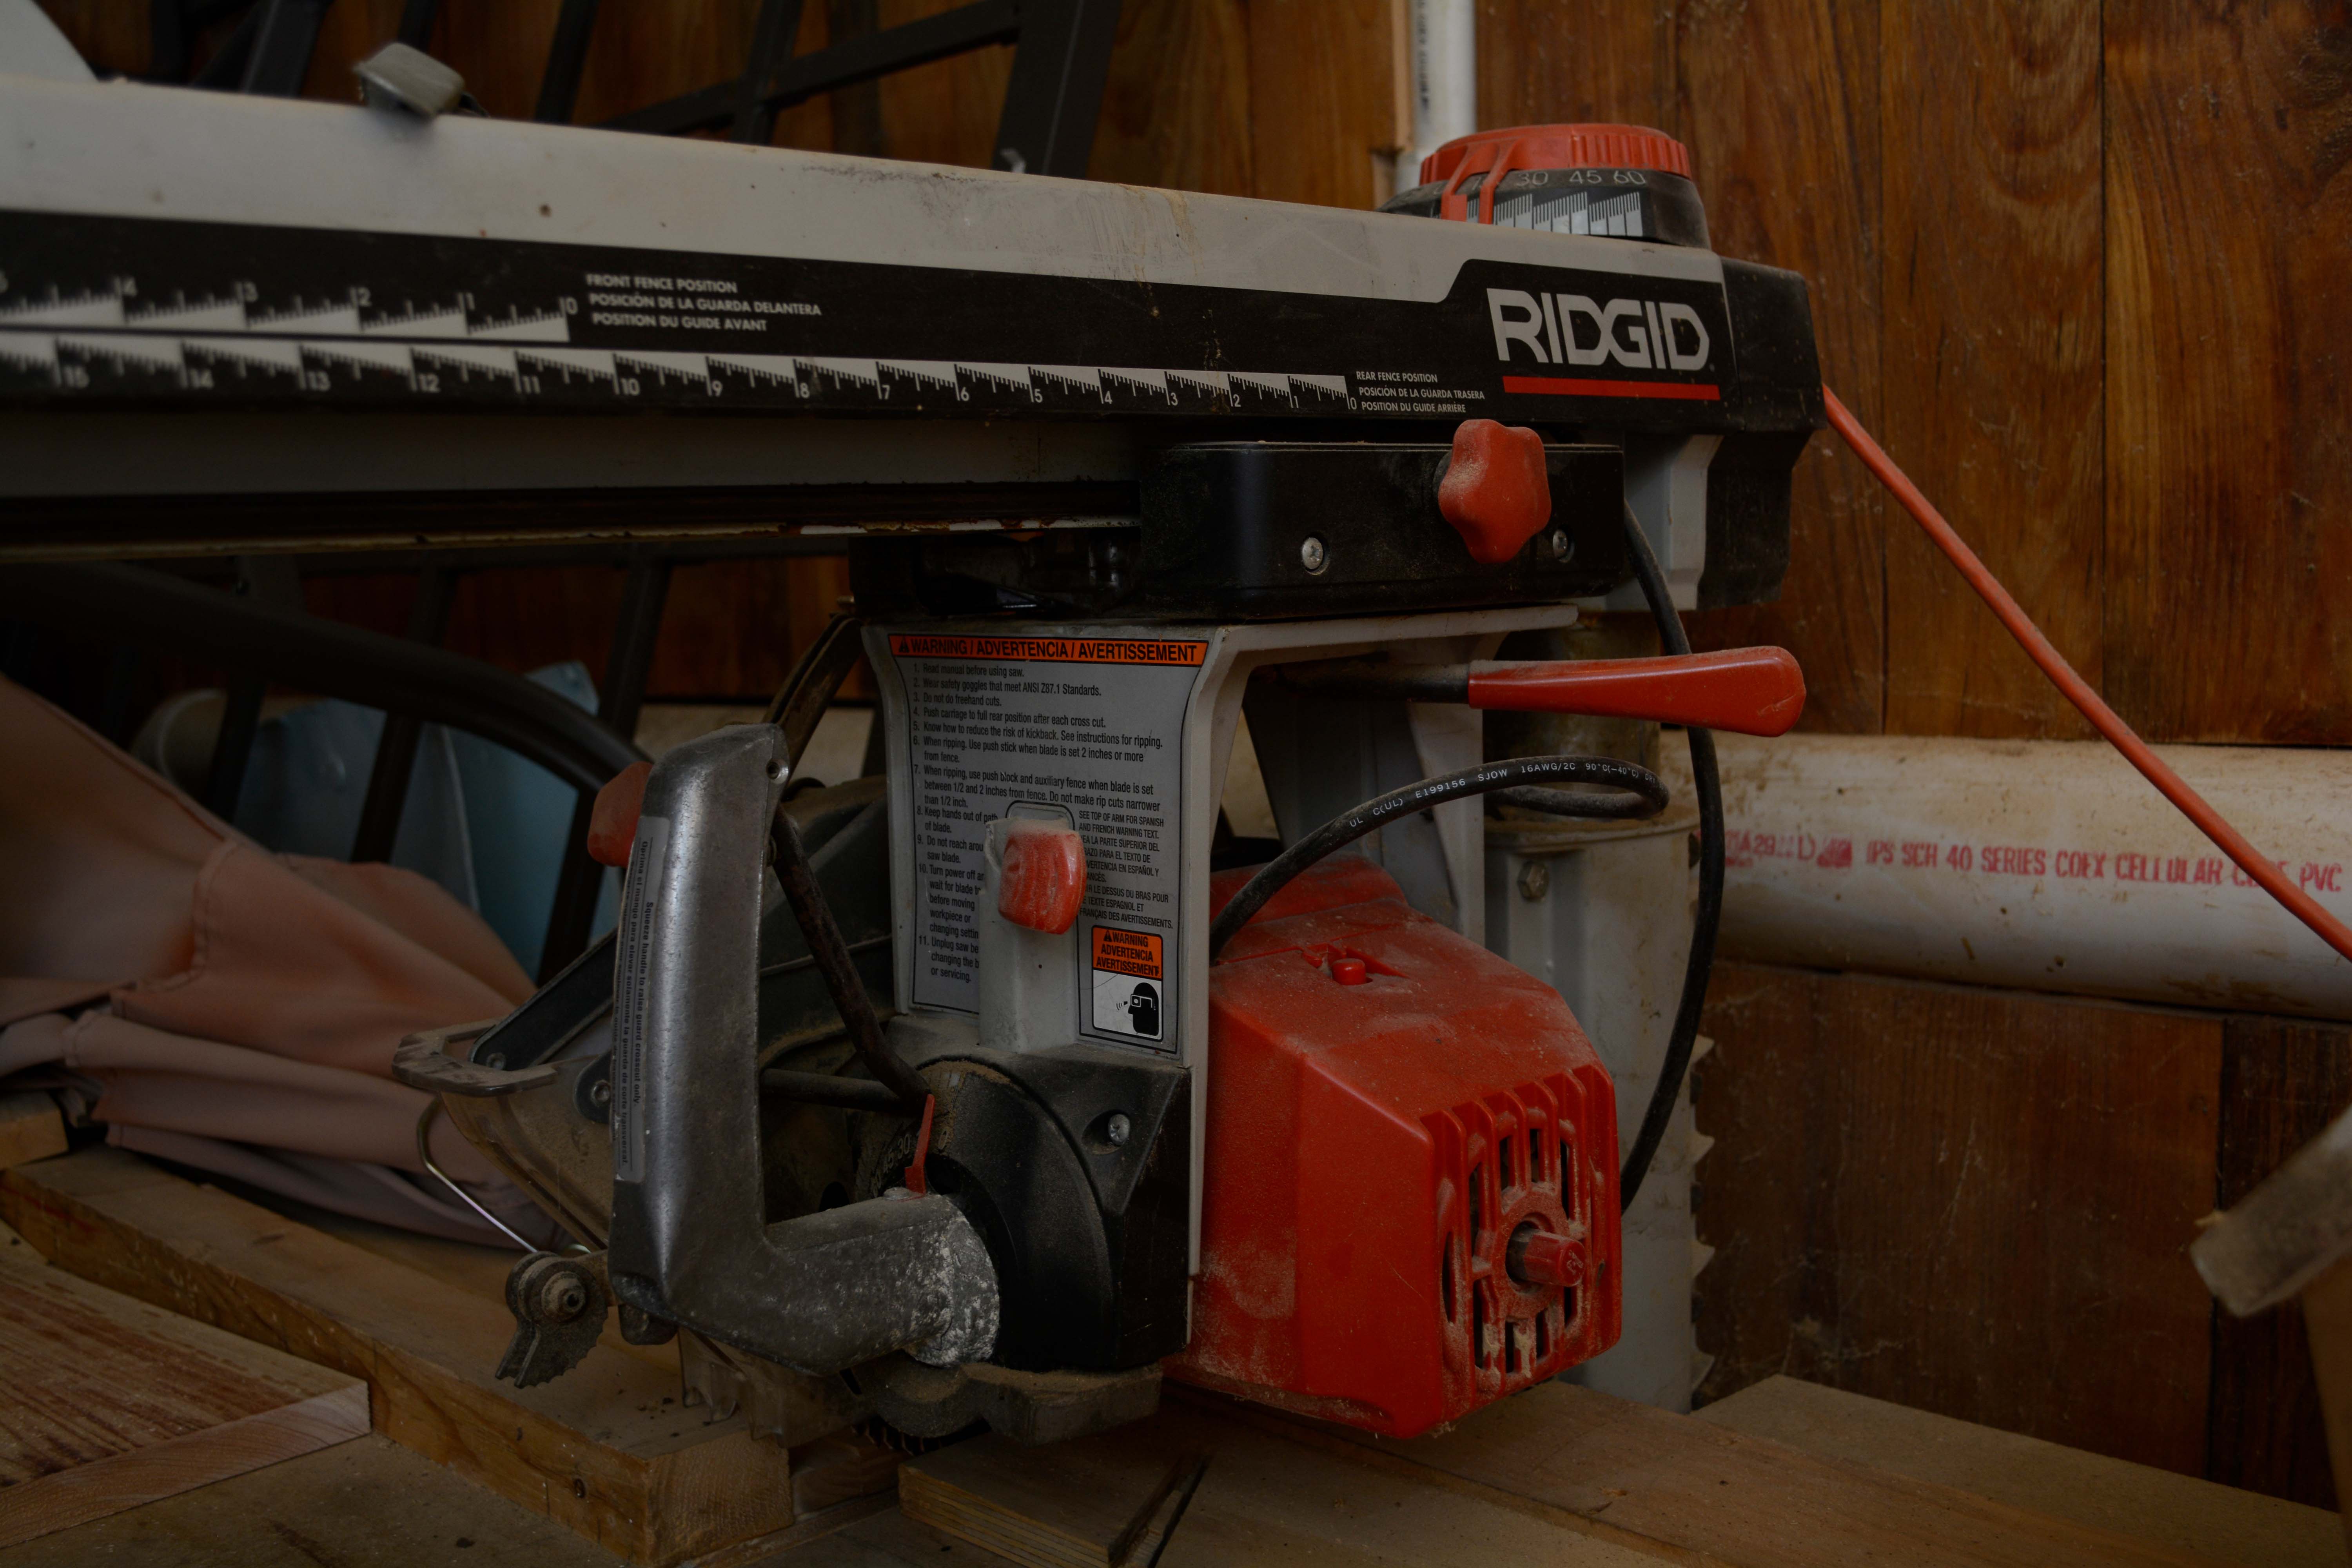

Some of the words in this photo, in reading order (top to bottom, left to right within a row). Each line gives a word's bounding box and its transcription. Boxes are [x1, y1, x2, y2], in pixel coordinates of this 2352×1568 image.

[1515, 171, 1548, 186] 30
[1570, 170, 1601, 184] 45
[1613, 171, 1646, 185] 60
[586, 274, 630, 287] FRONT
[634, 276, 673, 290] FENCE
[676, 278, 737, 293] POSITION
[123, 276, 138, 297] 4
[244, 279, 258, 303] 3
[358, 287, 371, 308] 2
[566, 297, 578, 314] 0
[589, 291, 655, 308] POSICIÓN
[657, 296, 674, 309] DE
[677, 298, 694, 310] LA
[696, 298, 751, 312] GUARDA
[753, 301, 822, 316] DELANTERA
[592, 312, 657, 327] POSITION
[659, 315, 679, 328] DU
[681, 316, 720, 330] GUIDE
[724, 318, 767, 331] AVANT
[1486, 288, 1710, 371] RIDGID
[1356, 371, 1376, 380] REAR
[1377, 372, 1400, 381] FENCE
[1402, 373, 1437, 382] POSITION
[308, 369, 330, 391] 13
[419, 374, 441, 392] 12
[522, 376, 541, 394] 11
[620, 378, 641, 396] 10
[711, 381, 723, 397] 9
[800, 383, 810, 399] 8
[882, 385, 890, 400] 7
[960, 387, 970, 401] 6
[1034, 389, 1043, 403] 5
[1104, 391, 1112, 404] 4
[1171, 392, 1178, 406] 3
[1234, 394, 1241, 408] 2
[1350, 397, 1357, 410] 0
[1359, 385, 1396, 396] POSICIÓN
[1410, 388, 1419, 397] LA
[1421, 389, 1452, 397] GUARDA
[1454, 390, 1485, 399] TRASERA
[1361, 401, 1398, 410] POSITION
[1400, 403, 1410, 411] DU
[1413, 403, 1435, 412] GUIDE
[1438, 402, 1465, 412] ARRIÈRE
[911, 639, 967, 654] WARNING
[977, 640, 1068, 657] ADVERTENCIA
[1078, 642, 1196, 661] AVERTISSEMENT
[914, 663, 919, 672] 1.
[923, 663, 939, 673] Read
[941, 664, 964, 674] manual
[966, 664, 987, 675] before
[989, 665, 1007, 678] using
[1009, 668, 1024, 677] saw.
[913, 677, 919, 687] 2.
[923, 677, 939, 688] Wear
[941, 679, 960, 690] safety
[962, 680, 987, 691] goggles
[989, 681, 1002, 691] that
[1004, 682, 1021, 691] meet
[1023, 682, 1038, 693] ANSI
[1041, 682, 1059, 693] Z87.1
[1063, 683, 1101, 695] Standards.
[913, 691, 919, 702] 3.
[924, 692, 931, 702] Do
[934, 693, 944, 702] not
[946, 694, 953, 703] do
[955, 694, 983, 705] freehand
[985, 696, 1001, 706] cuts.
[913, 706, 919, 716] 4.
[924, 707, 939, 717] Push
[941, 708, 967, 720] carriage
[969, 710, 975, 719] to
[977, 710, 987, 720] full
[989, 713, 1002, 721] rear
[1005, 712, 1031, 722] position
[1033, 713, 1049, 724] after
[1051, 715, 1068, 725] each
[1071, 717, 1090, 726] cross
[1092, 717, 1105, 728] cut.
[1349, 817, 1364, 828] UL
[1372, 798, 1404, 816] C(UL)
[1415, 779, 1466, 799] E199156
[1477, 769, 1508, 781] SJOW
[1521, 762, 1576, 773] 16AWG/2C
[1079, 810, 1089, 819] SEE
[1091, 811, 1101, 820] TOP
[1103, 813, 1110, 821] OF
[1111, 814, 1124, 822] ARM
[1126, 815, 1137, 824] FOR
[1139, 816, 1163, 826] SPANISH
[1079, 823, 1090, 831] AND
[1093, 824, 1114, 833] FRENCH
[1116, 827, 1142, 837] WARNING
[1143, 829, 1158, 838] TEXT.
[1091, 836, 1098, 844] LA
[1100, 837, 1117, 846] PARTE
[1119, 839, 1147, 850] SUPERIOR
[1149, 842, 1160, 851] DEL
[637, 841, 648, 874] Oprima
[1099, 849, 1113, 858] PARA
[1115, 851, 1122, 859] EL
[1123, 852, 1141, 862] TEXTO
[1143, 854, 1150, 863] DE
[1867, 840, 1894, 864] IPS
[1901, 840, 1938, 868] SCH
[1947, 844, 1973, 871] 40
[1982, 846, 2046, 876] SERIES
[2115, 853, 2223, 885] CELLULAR
[2299, 862, 2342, 891] PVC
[1118, 864, 1126, 872] EN
[1128, 865, 1154, 876] ESPAÑOL
[1155, 868, 1159, 876] Y
[635, 877, 642, 885] el
[1094, 885, 1100, 893] LE
[1102, 886, 1124, 897] DESSUS
[1126, 889, 1133, 898] DU
[1136, 891, 1151, 900] BRAS
[1152, 893, 1168, 902] POUR
[631, 888, 641, 919] mango
[1088, 897, 1104, 906] TEXTE
[1106, 899, 1135, 911] ESPAGNOL
[1137, 903, 1143, 911] ET
[642, 902, 653, 940] Squeeze
[1109, 911, 1120, 920] DES
[1121, 913, 1172, 928] AVERTISSEMENTS.
[629, 921, 637, 942] para
[1112, 931, 1148, 947] WARNING
[627, 944, 636, 973] elevar
[639, 942, 649, 974] handle
[1101, 944, 1154, 962] ADVERTENCIA
[1096, 956, 1159, 976] AVERTISSEMENT
[638, 976, 646, 985] to
[624, 975, 633, 1024] solamente
[636, 988, 645, 1011] raise
[623, 1027, 630, 1035] la
[634, 1014, 643, 1040] guard
[633, 1043, 642, 1082] crosscut
[621, 1072, 628, 1083] de
[632, 1084, 641, 1106] only.
